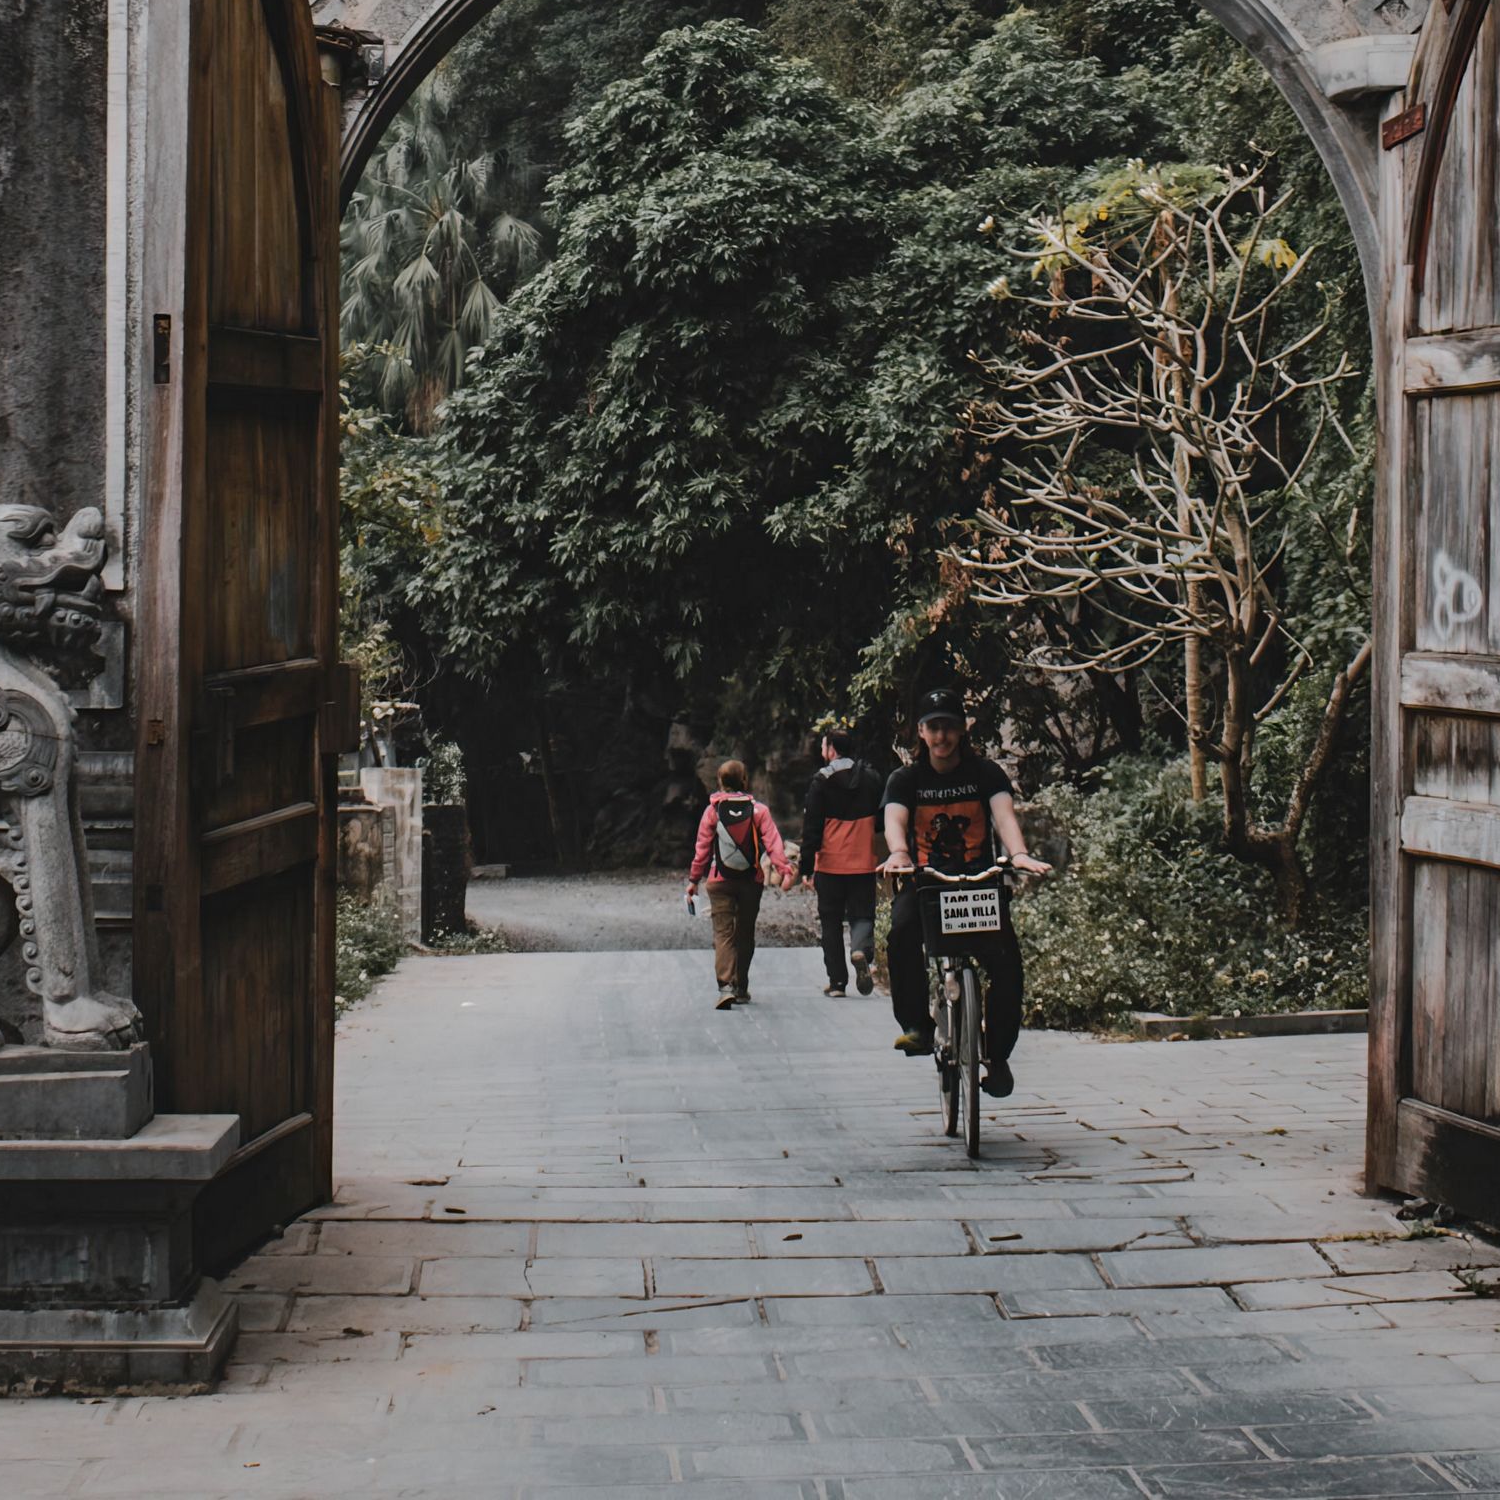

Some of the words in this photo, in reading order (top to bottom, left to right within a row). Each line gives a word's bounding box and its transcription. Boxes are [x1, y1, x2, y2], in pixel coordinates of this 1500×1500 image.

[943, 895, 968, 904] TAM
[972, 893, 996, 902] COC
[944, 907, 969, 919] SANA
[972, 905, 997, 917] VILLA
